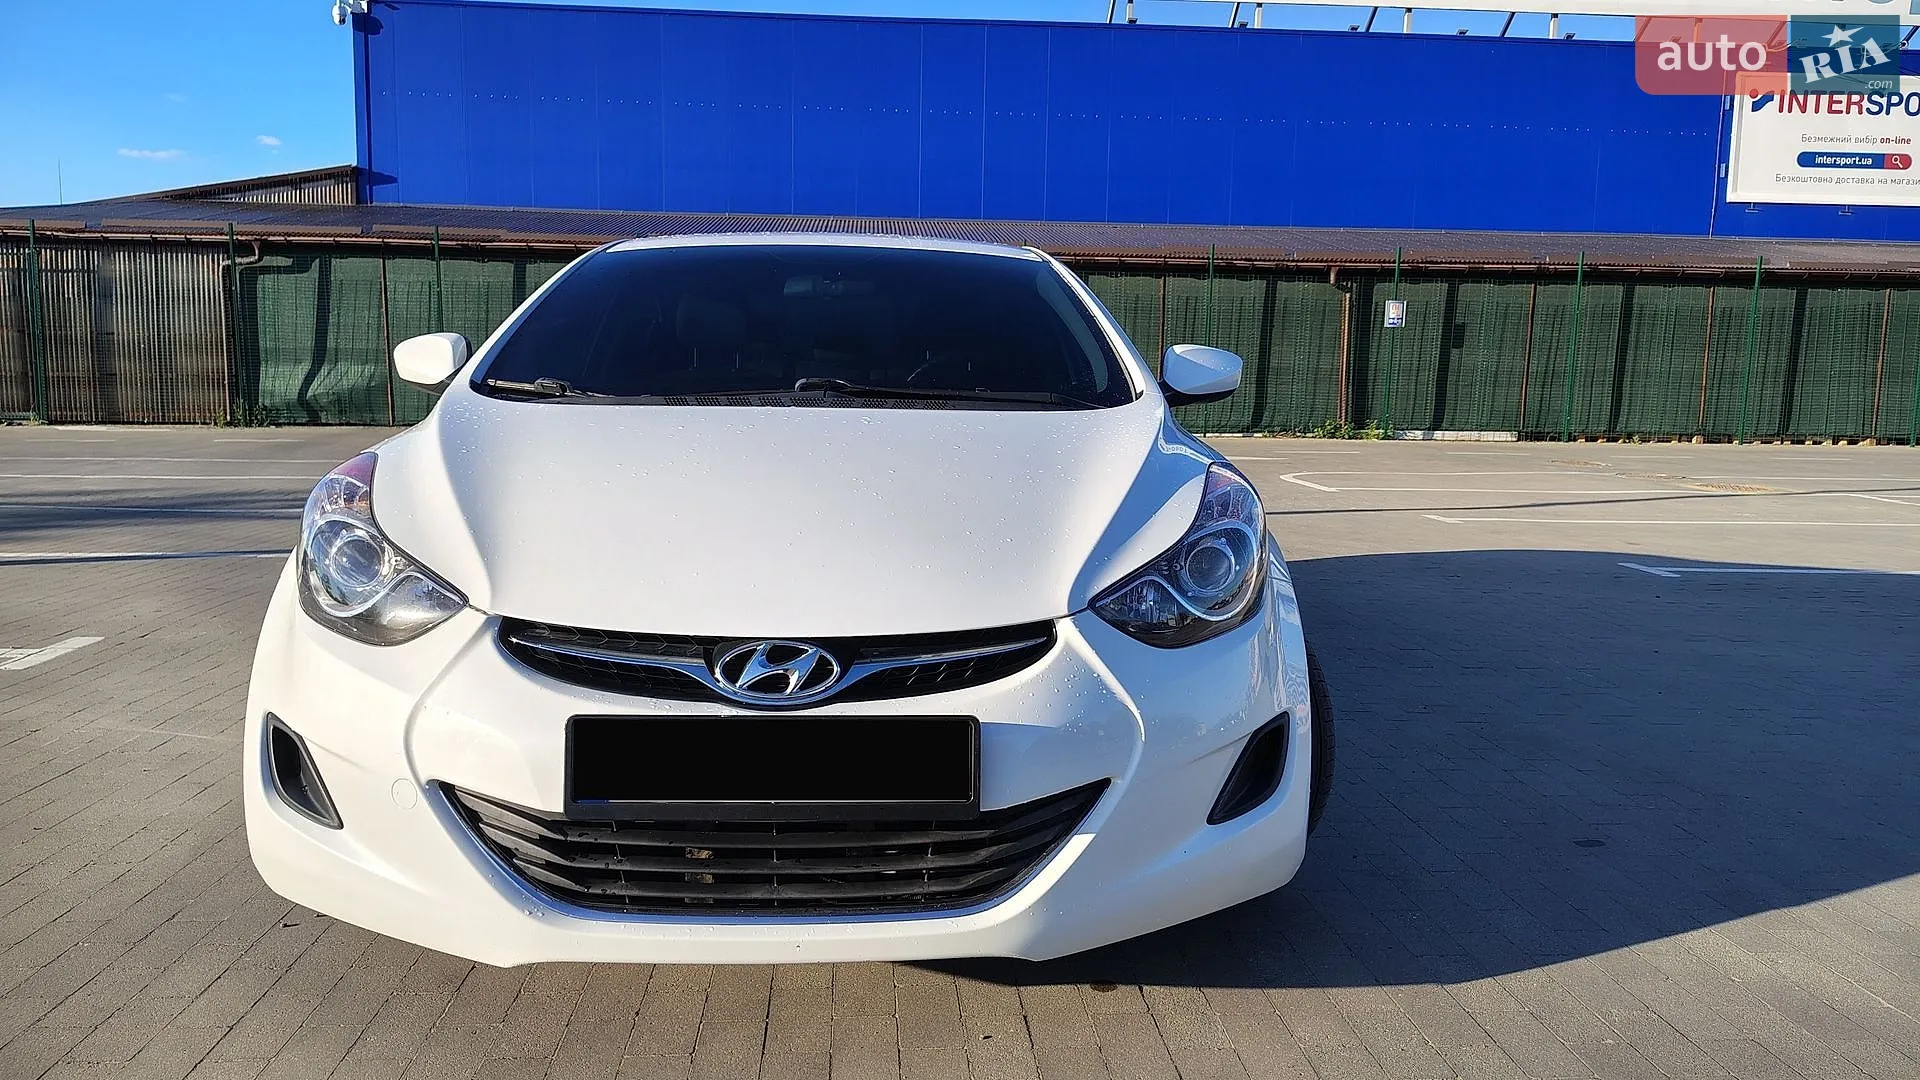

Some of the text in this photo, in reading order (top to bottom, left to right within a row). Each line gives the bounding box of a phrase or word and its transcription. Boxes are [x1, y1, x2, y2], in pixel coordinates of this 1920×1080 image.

[1801, 133, 1912, 146] Безмежний вибір on-line
[1815, 154, 1873, 167] intersport.ua
[1775, 173, 1833, 184] Безкоштовна
[1834, 176, 1875, 185] доставка
